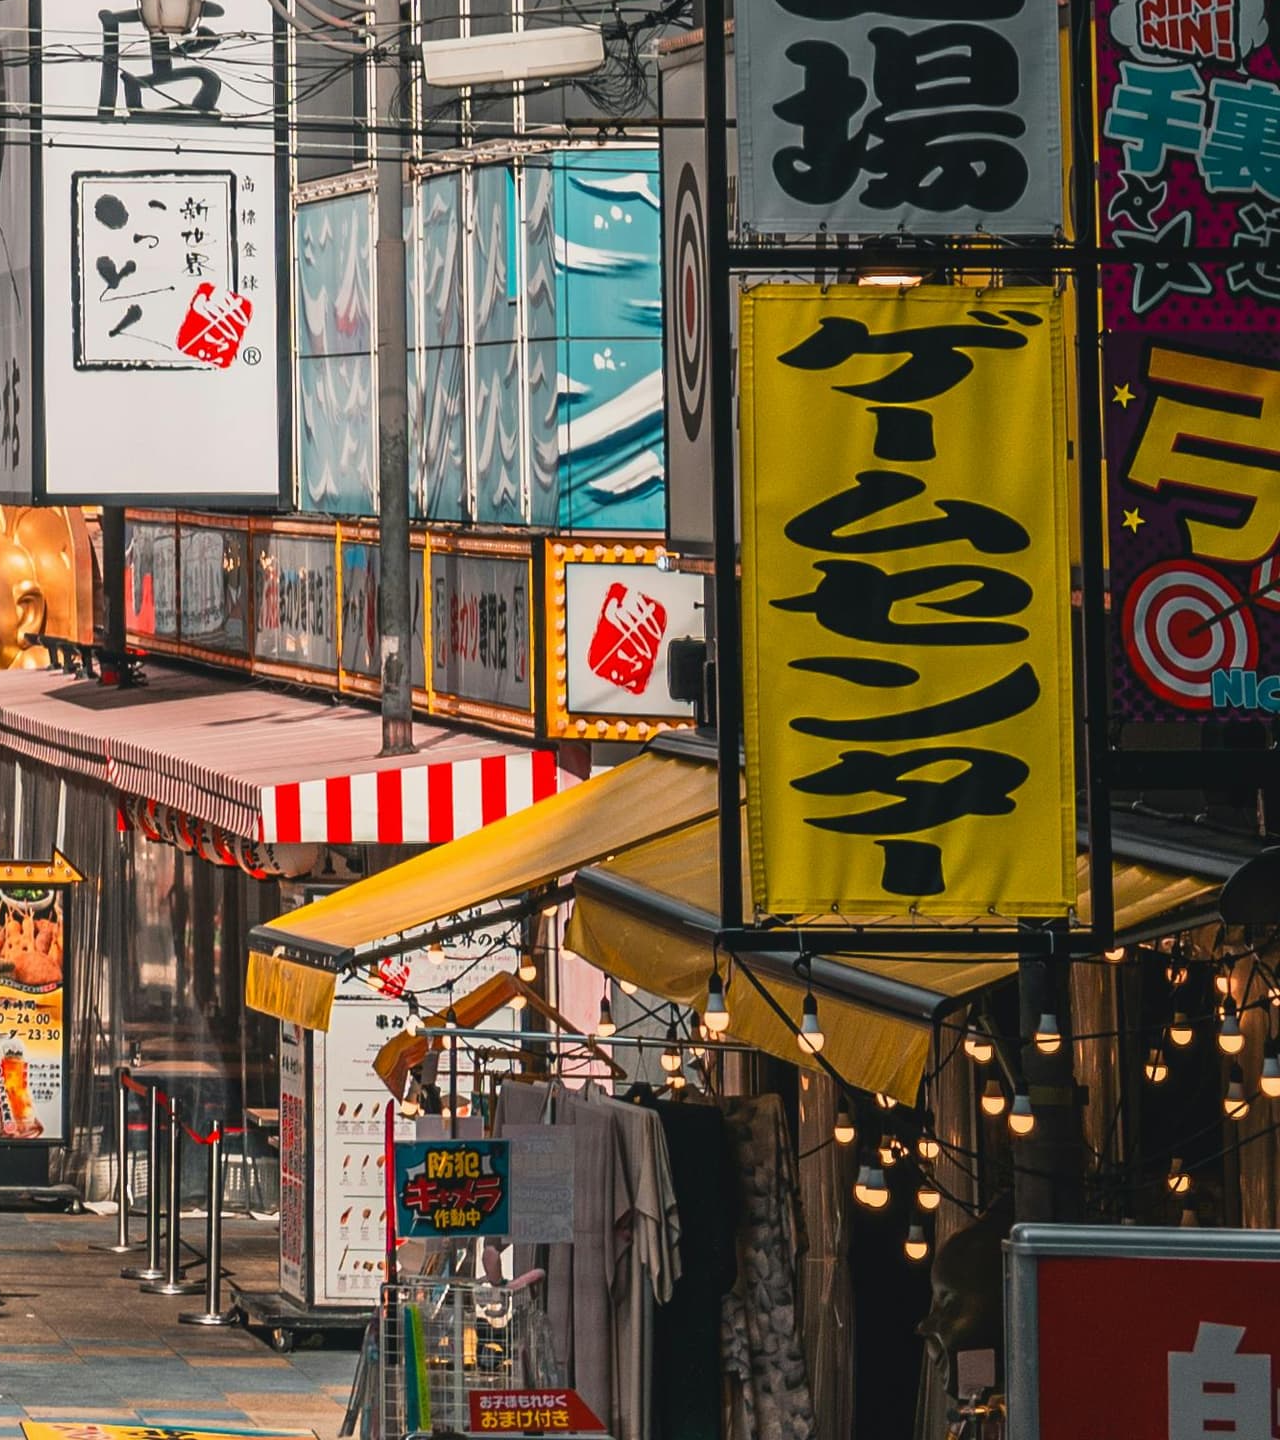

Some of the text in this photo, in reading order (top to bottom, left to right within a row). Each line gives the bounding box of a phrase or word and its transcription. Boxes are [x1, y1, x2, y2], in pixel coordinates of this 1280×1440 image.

[771, 307, 1045, 897] ゲームセンター
[426, 1151, 481, 1179] 防犯
[433, 1208, 481, 1229] 作動中
[479, 1394, 568, 1409] お子様もれなく
[480, 1410, 569, 1429] おまけ付き
